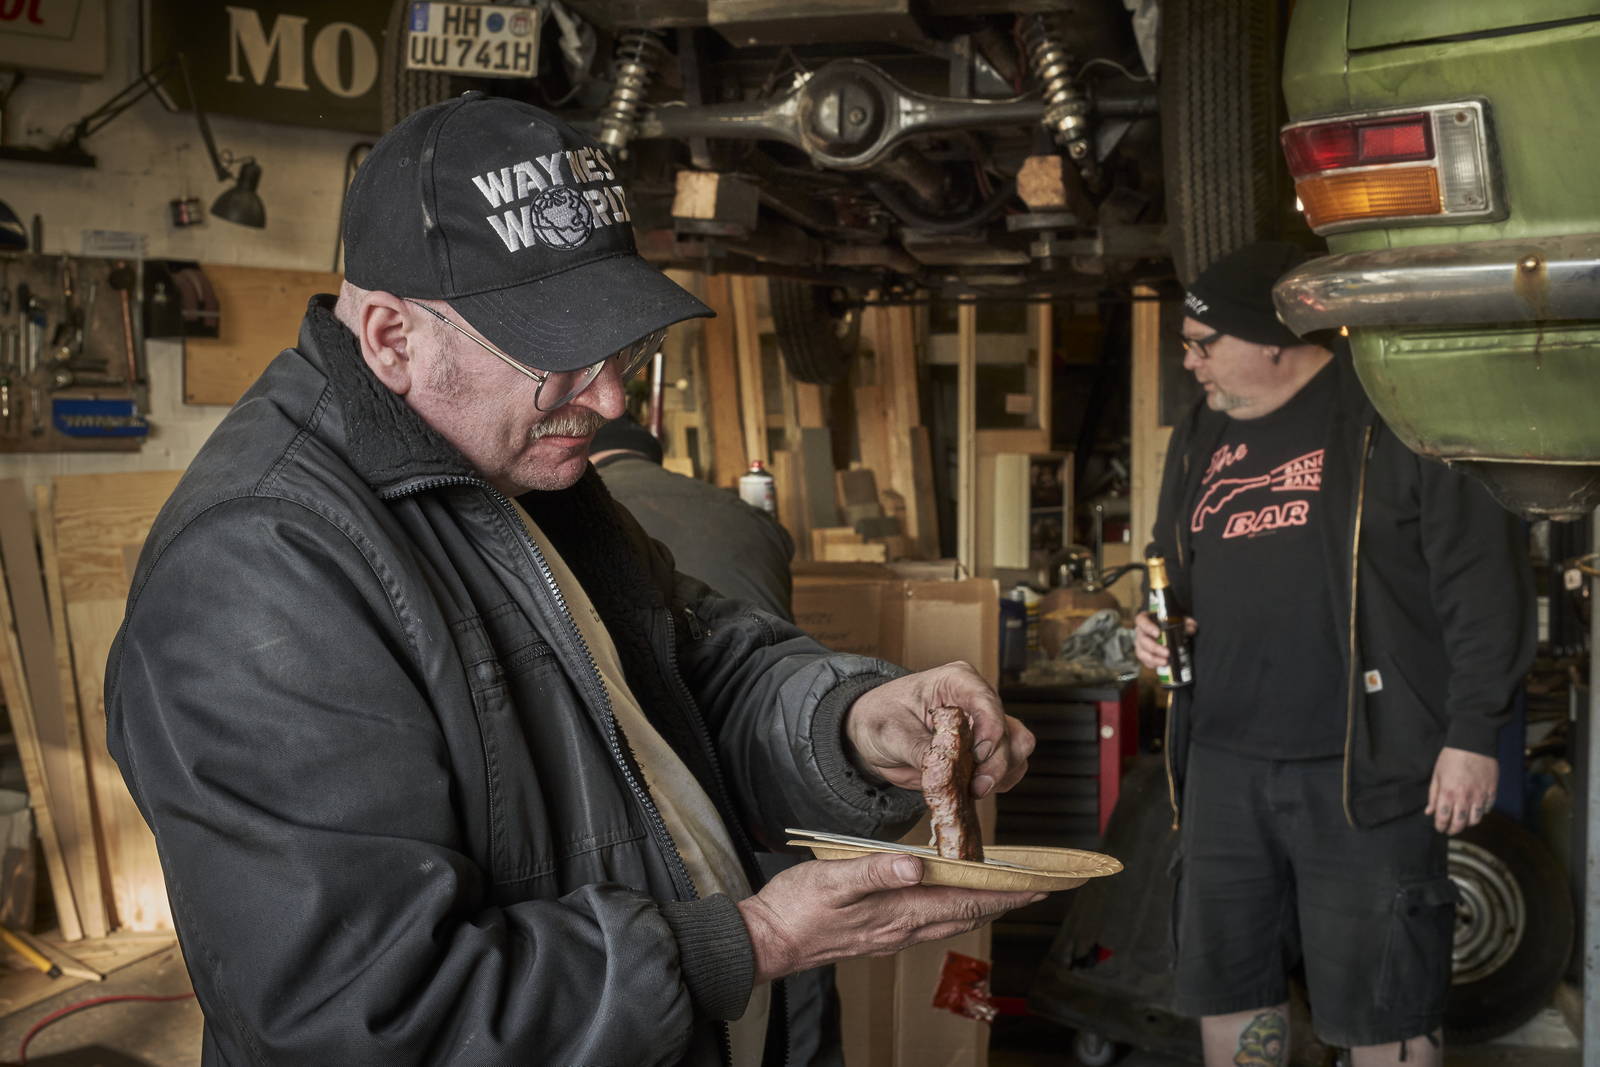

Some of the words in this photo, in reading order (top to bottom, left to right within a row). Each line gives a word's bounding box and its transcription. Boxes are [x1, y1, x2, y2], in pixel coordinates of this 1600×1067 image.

[443, 5, 482, 37] HH
[411, 35, 449, 66] UU
[456, 38, 533, 72] 741H
[1283, 472, 1322, 487] BAN
[1222, 500, 1309, 539] BAR
